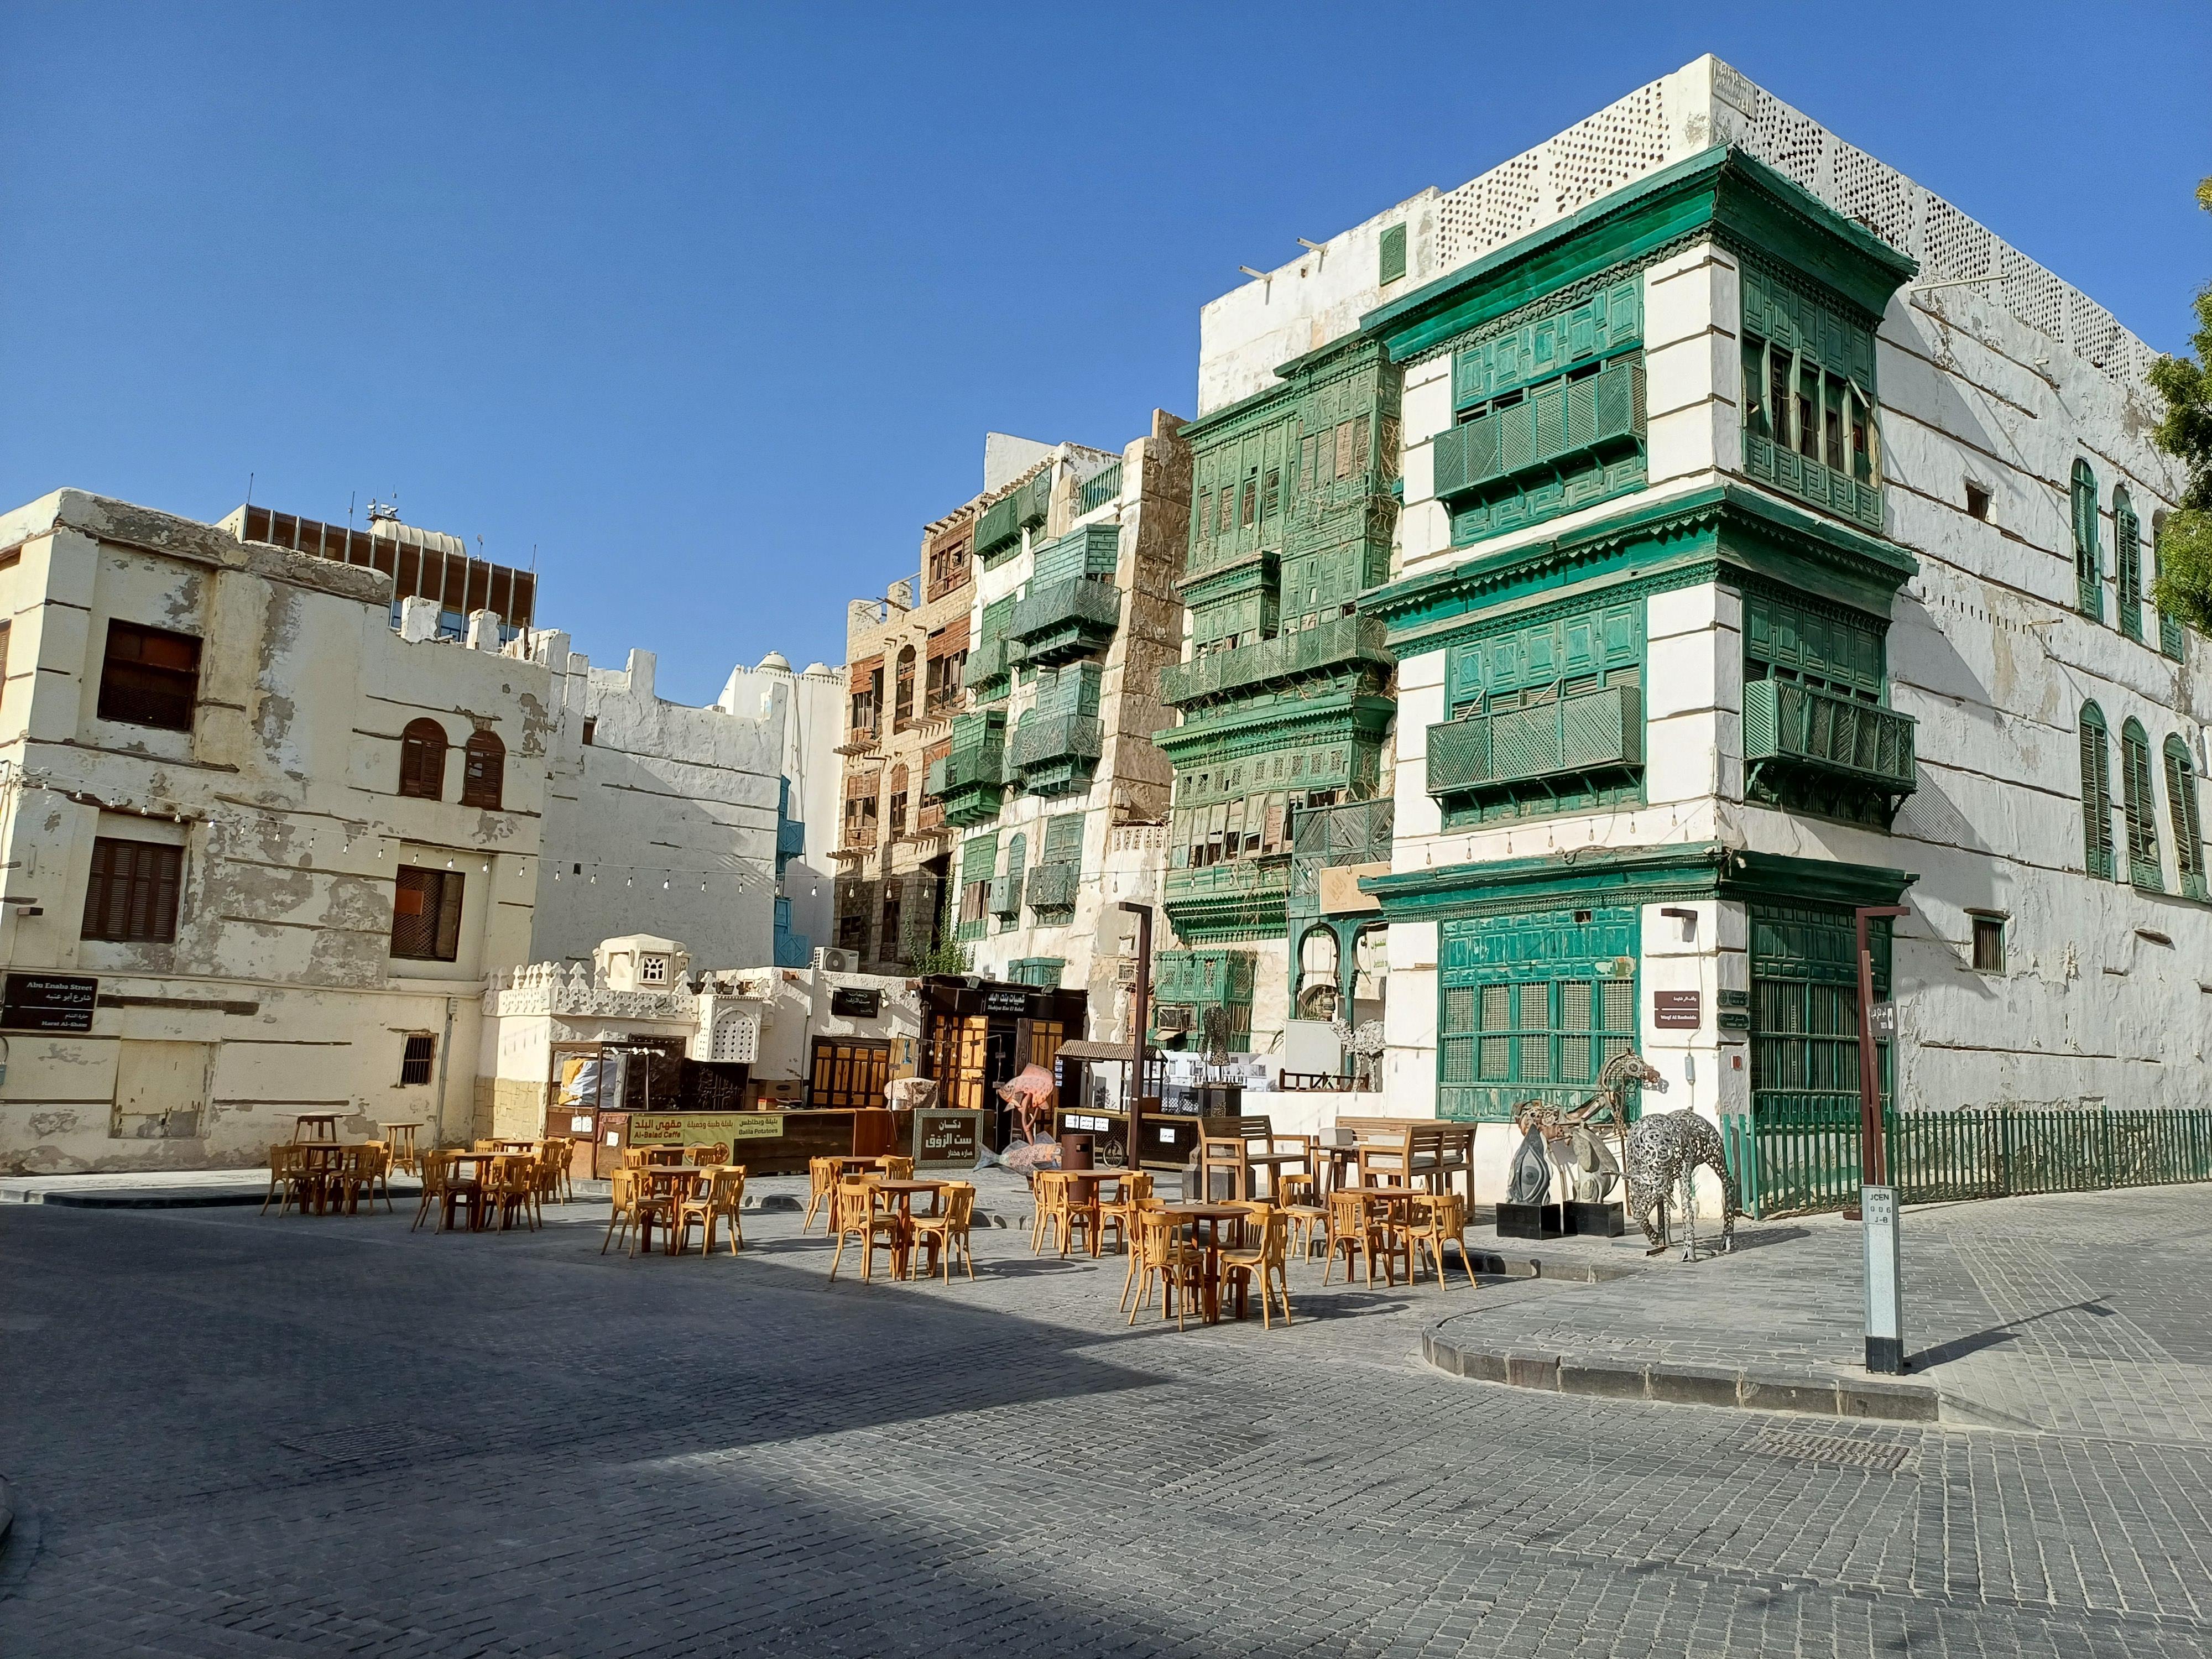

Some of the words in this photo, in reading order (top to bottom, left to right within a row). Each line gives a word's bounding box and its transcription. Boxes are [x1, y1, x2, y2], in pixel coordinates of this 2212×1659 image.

[62, 993, 72, 1001] أبو
[988, 992, 999, 1005] البلد
[1000, 993, 1009, 1005] بنت
[1009, 994, 1025, 1006] شعبيات
[635, 1119, 654, 1129] البلد
[656, 1120, 682, 1131] مقهى
[687, 1120, 706, 1129] وجميلة
[739, 1119, 765, 1128] وبطاطس
[939, 1119, 961, 1131] دكان
[954, 1134, 972, 1144] ست
